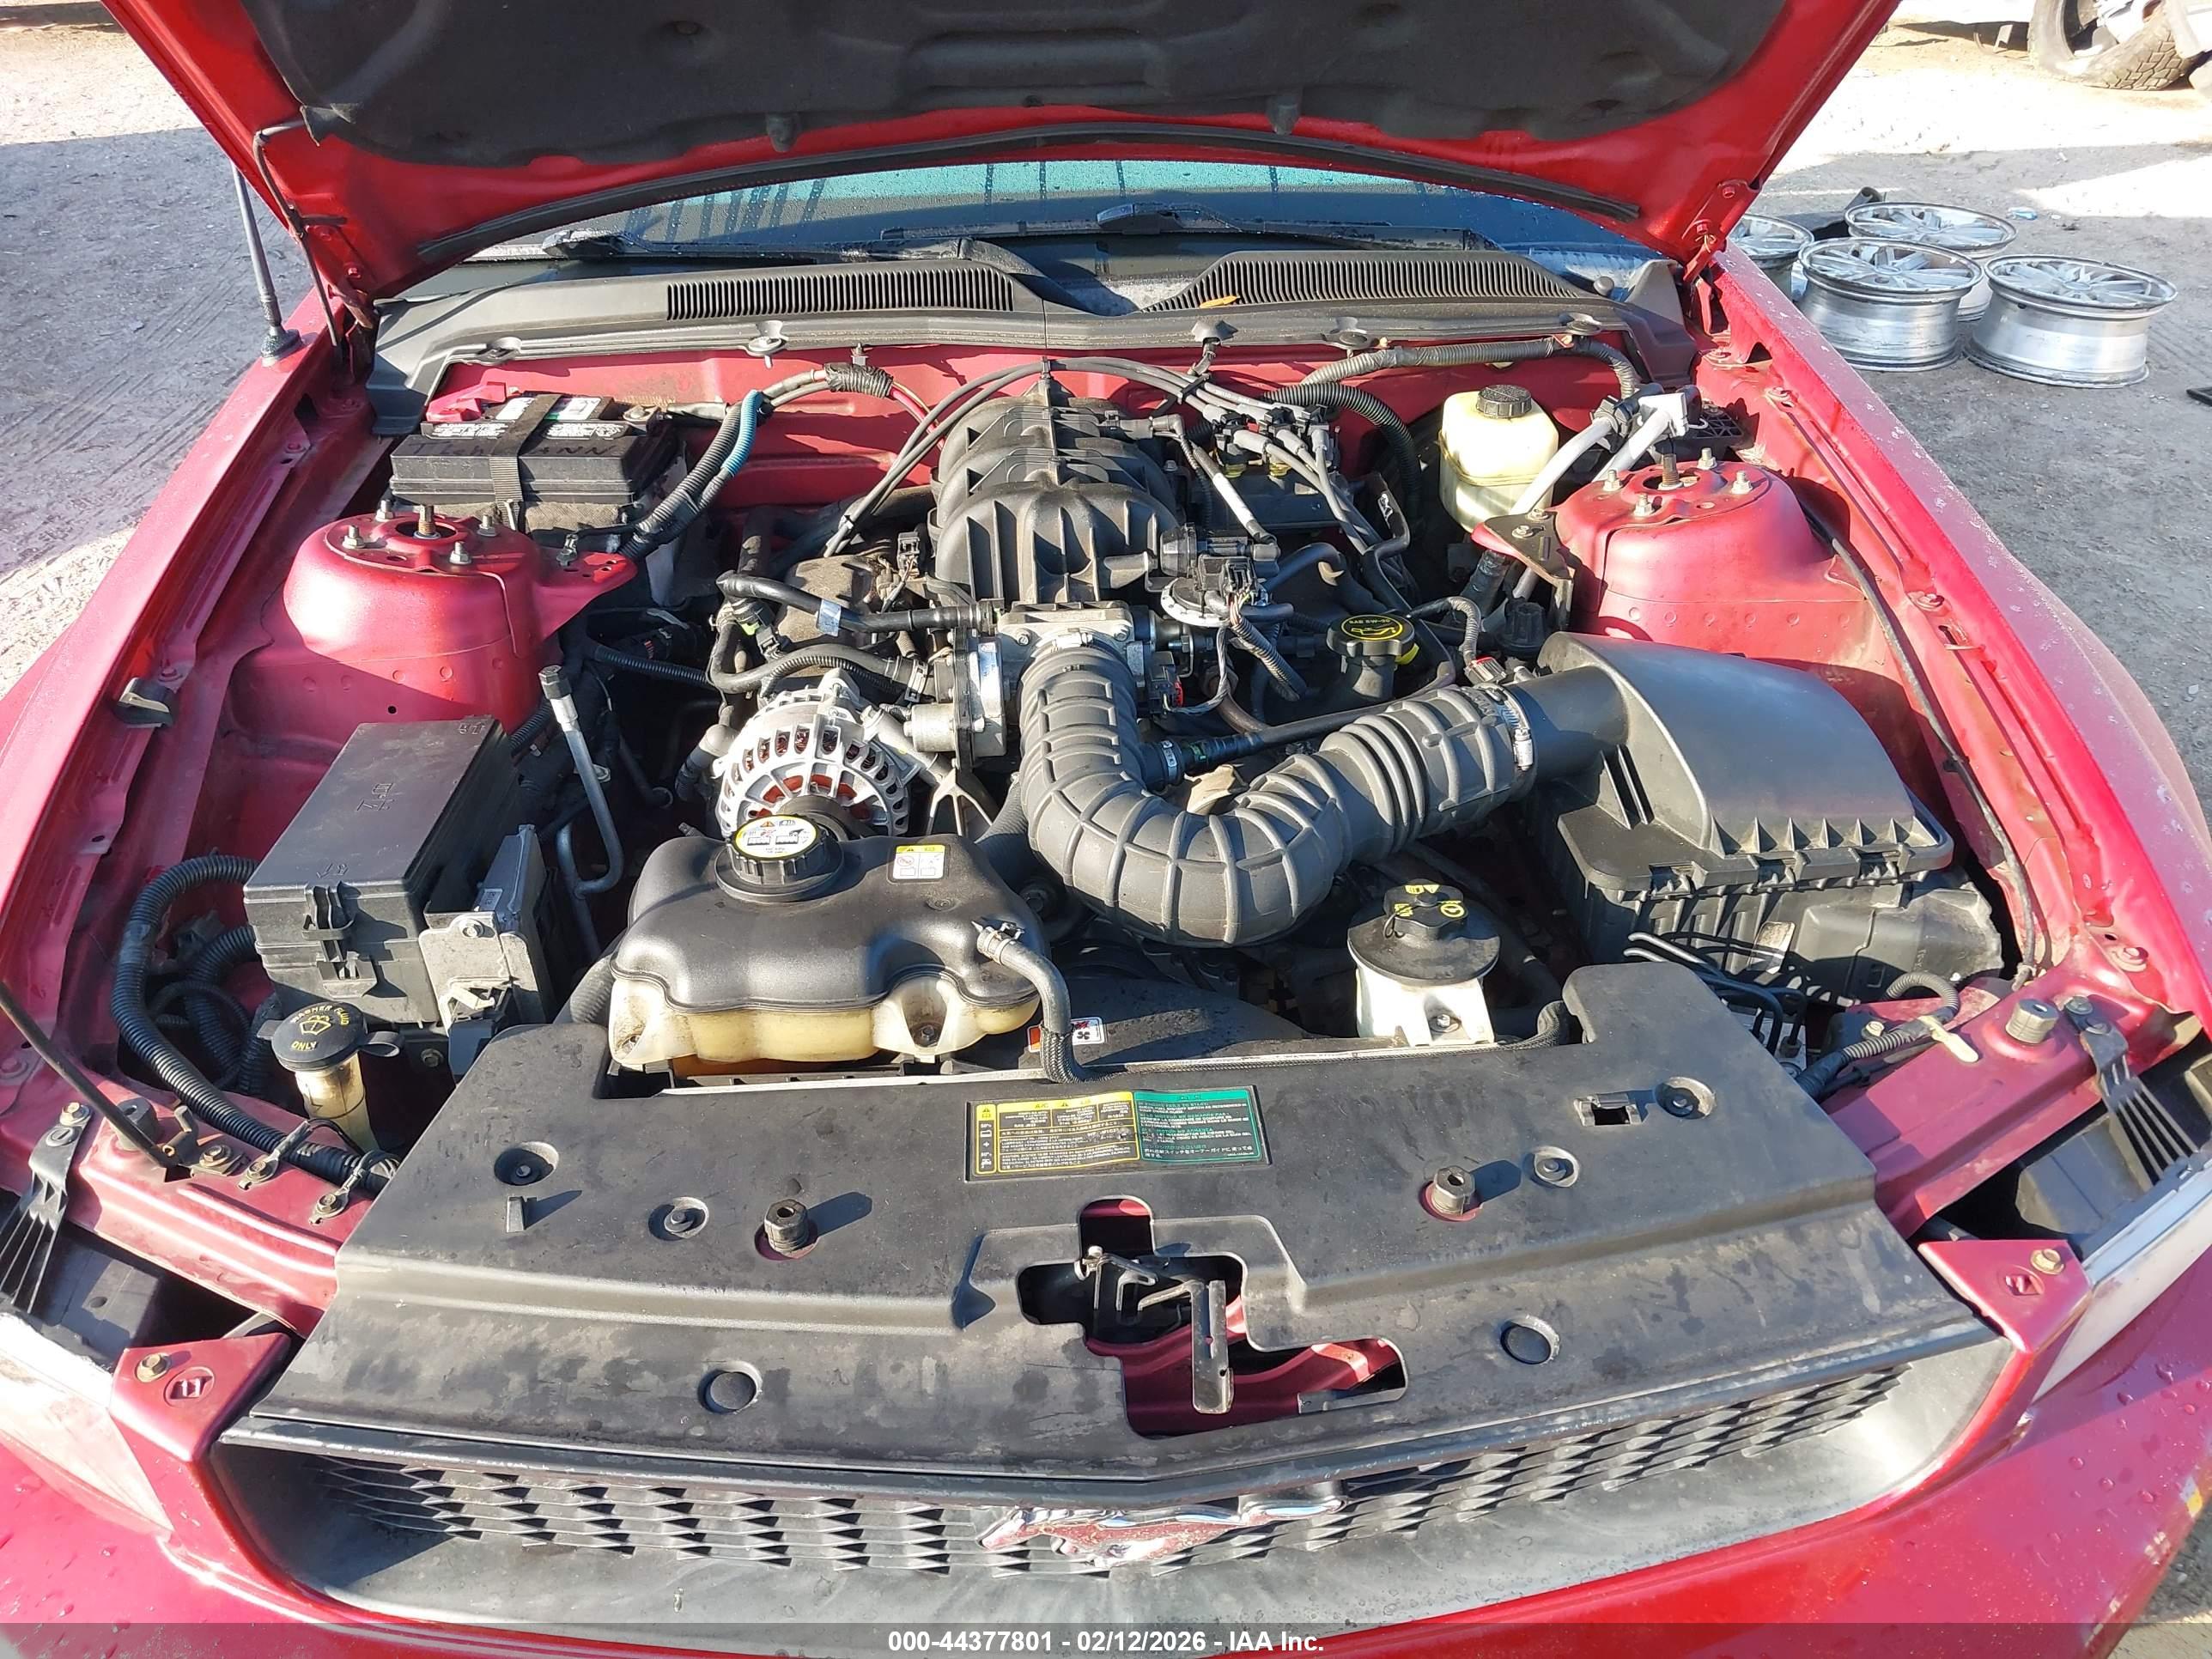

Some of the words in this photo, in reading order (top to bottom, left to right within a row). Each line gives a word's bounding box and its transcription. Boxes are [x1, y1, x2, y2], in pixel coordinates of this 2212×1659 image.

[289, 1005, 333, 1024] WASHER
[334, 1007, 349, 1025] FLUID
[291, 1040, 318, 1051] ONLY
